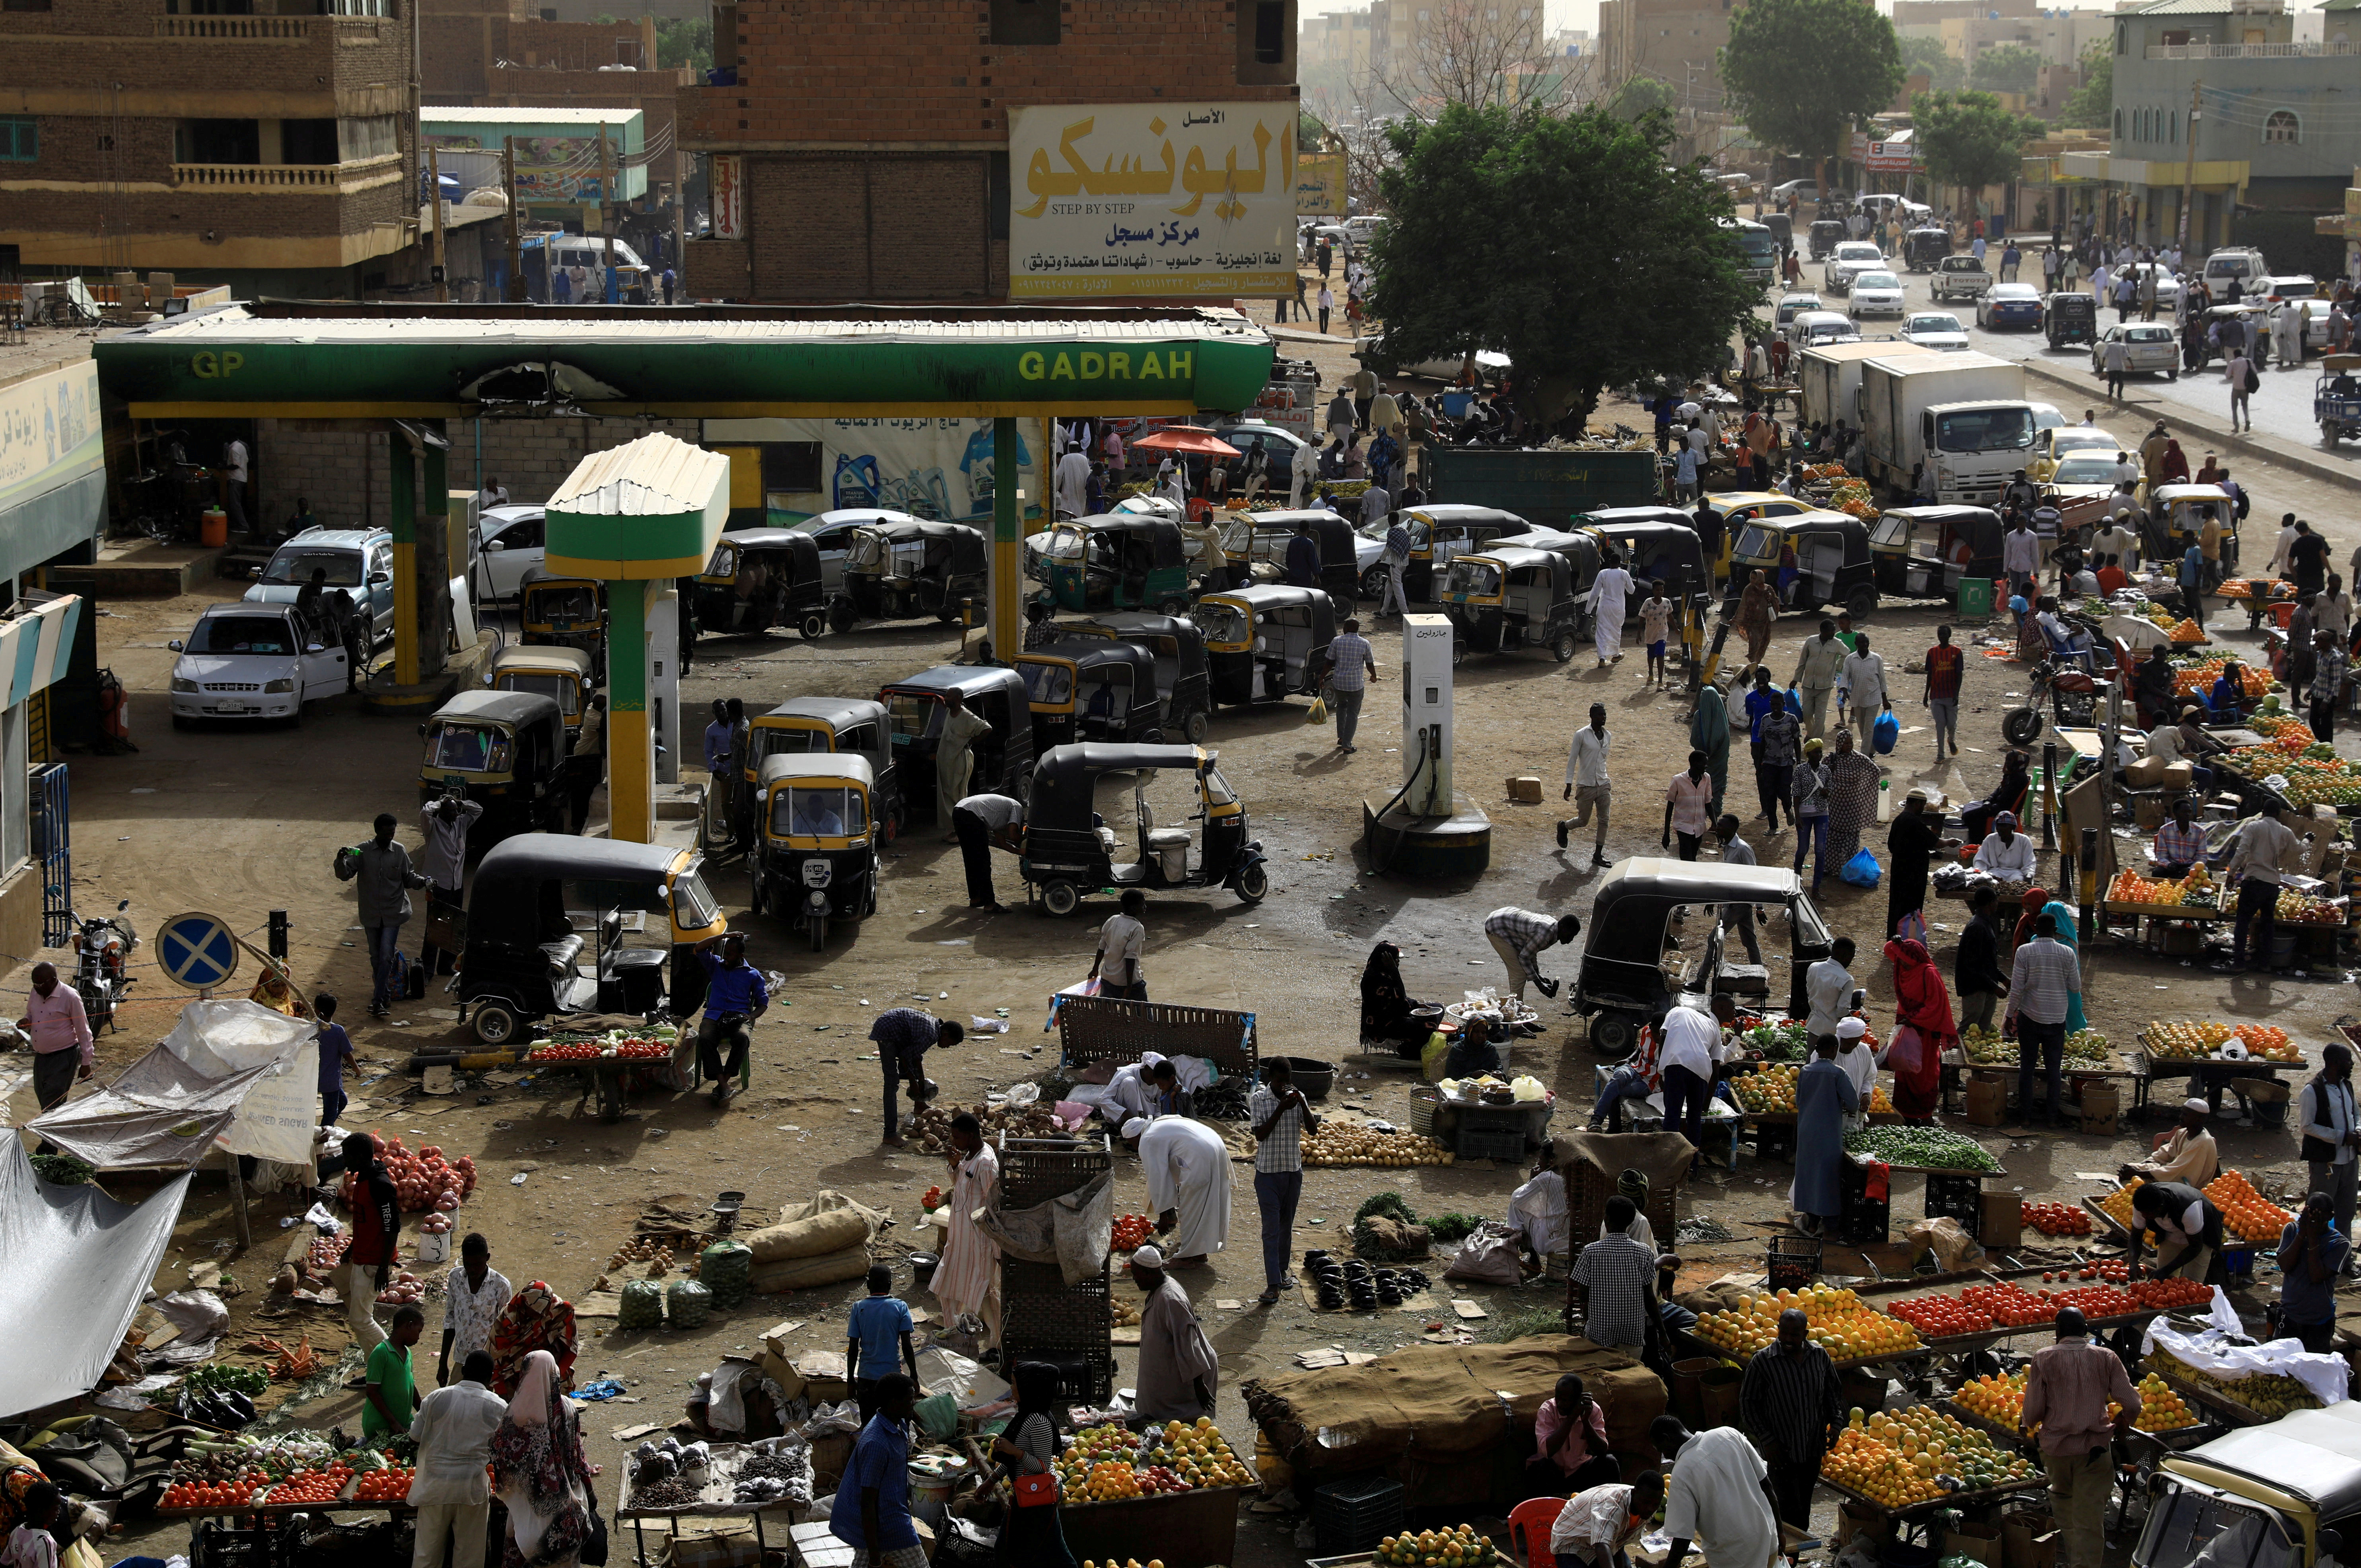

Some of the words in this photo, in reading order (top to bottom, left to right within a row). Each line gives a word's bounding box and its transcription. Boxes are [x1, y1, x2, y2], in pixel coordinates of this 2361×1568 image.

[1014, 115, 1292, 219] اليونسكو
[1052, 204, 1082, 214] STEP
[1085, 204, 1101, 214] BY
[1105, 203, 1135, 214] STEP
[1105, 222, 1153, 246] مسجل
[1157, 221, 1199, 246] مركز
[1064, 255, 1099, 267] معتمدة
[1166, 256, 1202, 269] حاسوب
[1216, 252, 1262, 269] إنجليزية
[1264, 251, 1282, 265] لغة
[1241, 275, 1287, 290] للإستفسار
[191, 351, 244, 378] GP
[1018, 351, 1191, 380] GADRAH
[1416, 629, 1447, 638] جازولين
